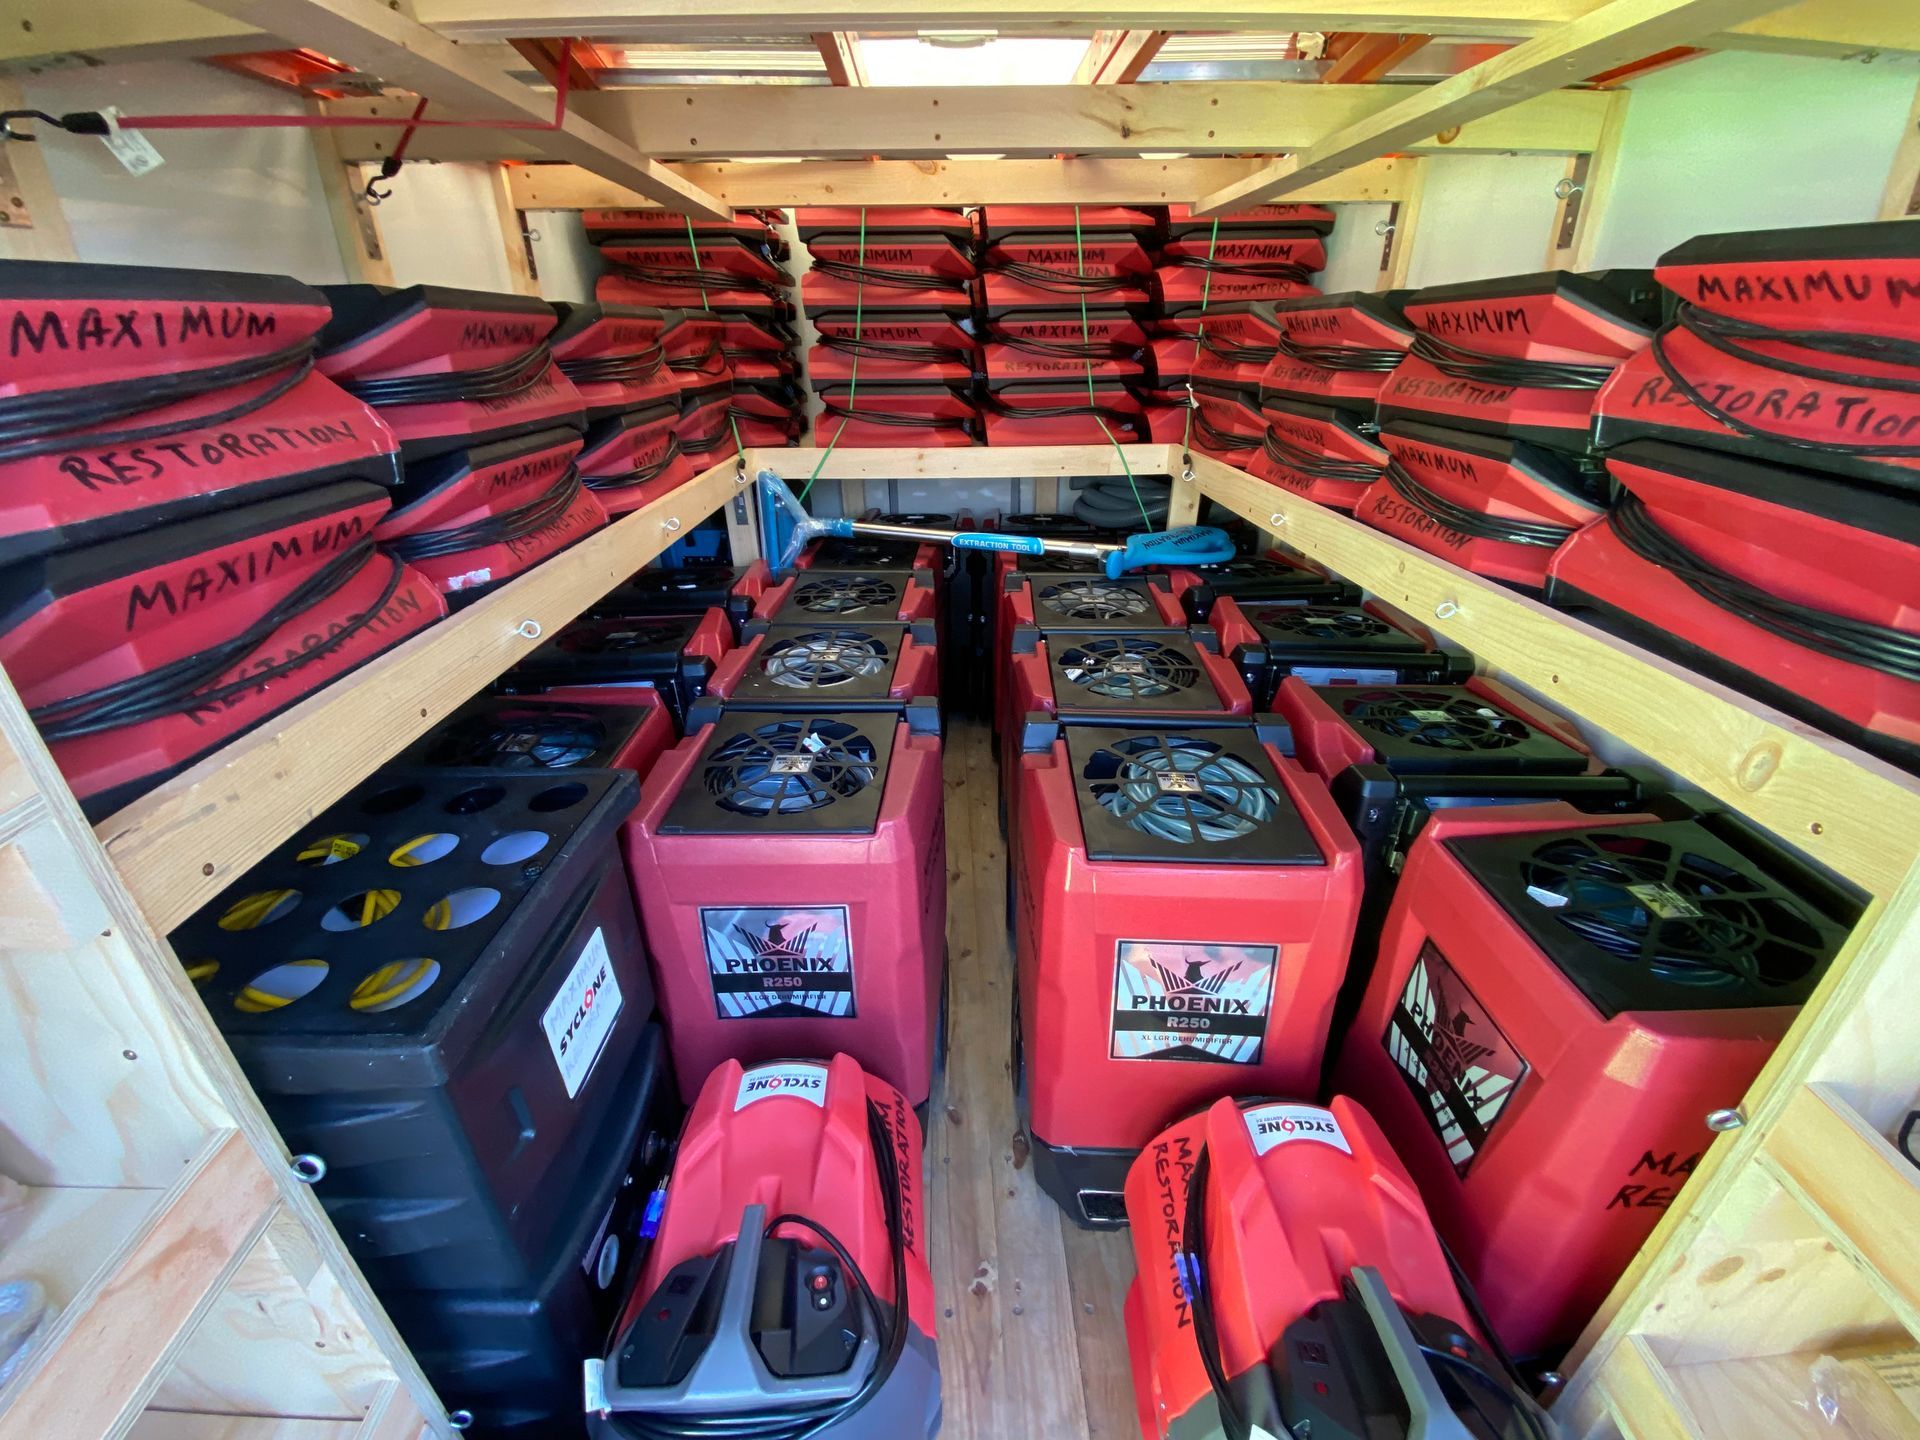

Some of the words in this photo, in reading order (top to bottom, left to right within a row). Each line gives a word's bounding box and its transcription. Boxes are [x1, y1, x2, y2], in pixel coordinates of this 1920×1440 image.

[839, 248, 912, 261] MAXIMUM
[1027, 249, 1105, 264] MAXIMUM
[1214, 244, 1294, 259] MAXIMUM
[1286, 315, 1341, 335] MAXIMUM
[1425, 307, 1530, 335] MAXIMUM
[11, 306, 276, 357] MAXIMUM
[1020, 325, 1109, 338] MAXIMUM
[1392, 376, 1518, 405] RESTORATION
[59, 421, 358, 490] RESTORATION
[1396, 443, 1478, 483] MAXIMUM
[1373, 494, 1473, 551] RESTORATION
[959, 538, 1009, 550] EXTRACTION
[1012, 543, 1031, 552] TOOL
[126, 516, 362, 632] MAXIMUM
[724, 957, 835, 973] PHOENIX
[762, 976, 803, 988] R250
[560, 962, 607, 1058] SYCLONE
[1131, 994, 1250, 1014] PHOENIX
[1166, 1016, 1211, 1029] R250
[1172, 1036, 1233, 1045] DEHUMIDIFIER
[1410, 1001, 1484, 1114] PHOENIX
[746, 1075, 821, 1092] SYCLONE
[1258, 1117, 1336, 1135] SYCLONE
